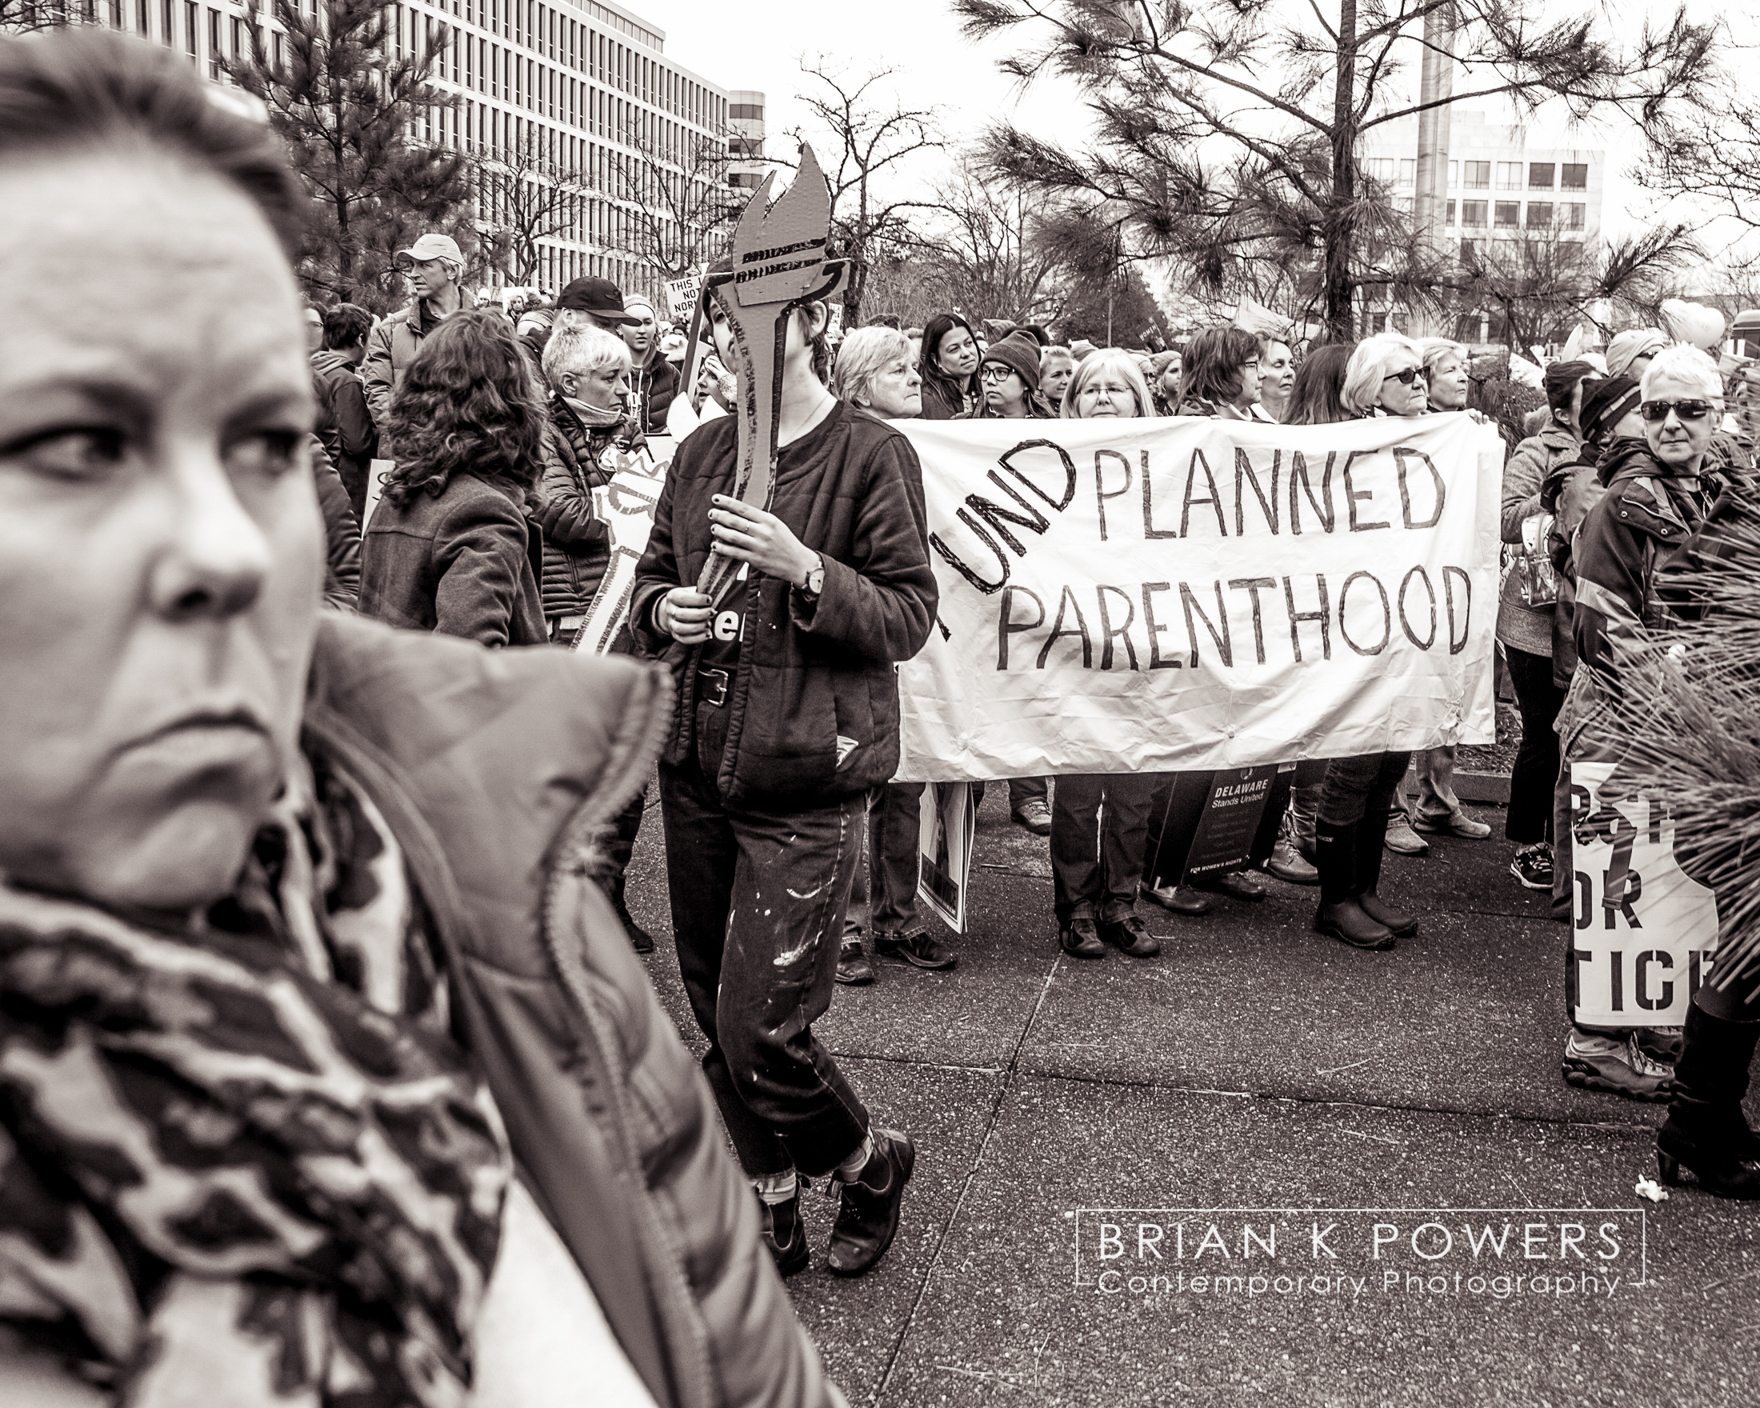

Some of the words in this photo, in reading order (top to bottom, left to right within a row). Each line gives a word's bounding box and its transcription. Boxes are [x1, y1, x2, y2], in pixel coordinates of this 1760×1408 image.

[670, 279, 692, 292] THIS
[928, 438, 1077, 596] UND
[1094, 446, 1447, 541] PLANNED
[997, 565, 1472, 671] PARENTHOOD
[1215, 779, 1268, 798] DELAWARE
[1212, 797, 1239, 809] Stands
[1240, 792, 1264, 804] United
[1225, 858, 1242, 866] RIGHTS
